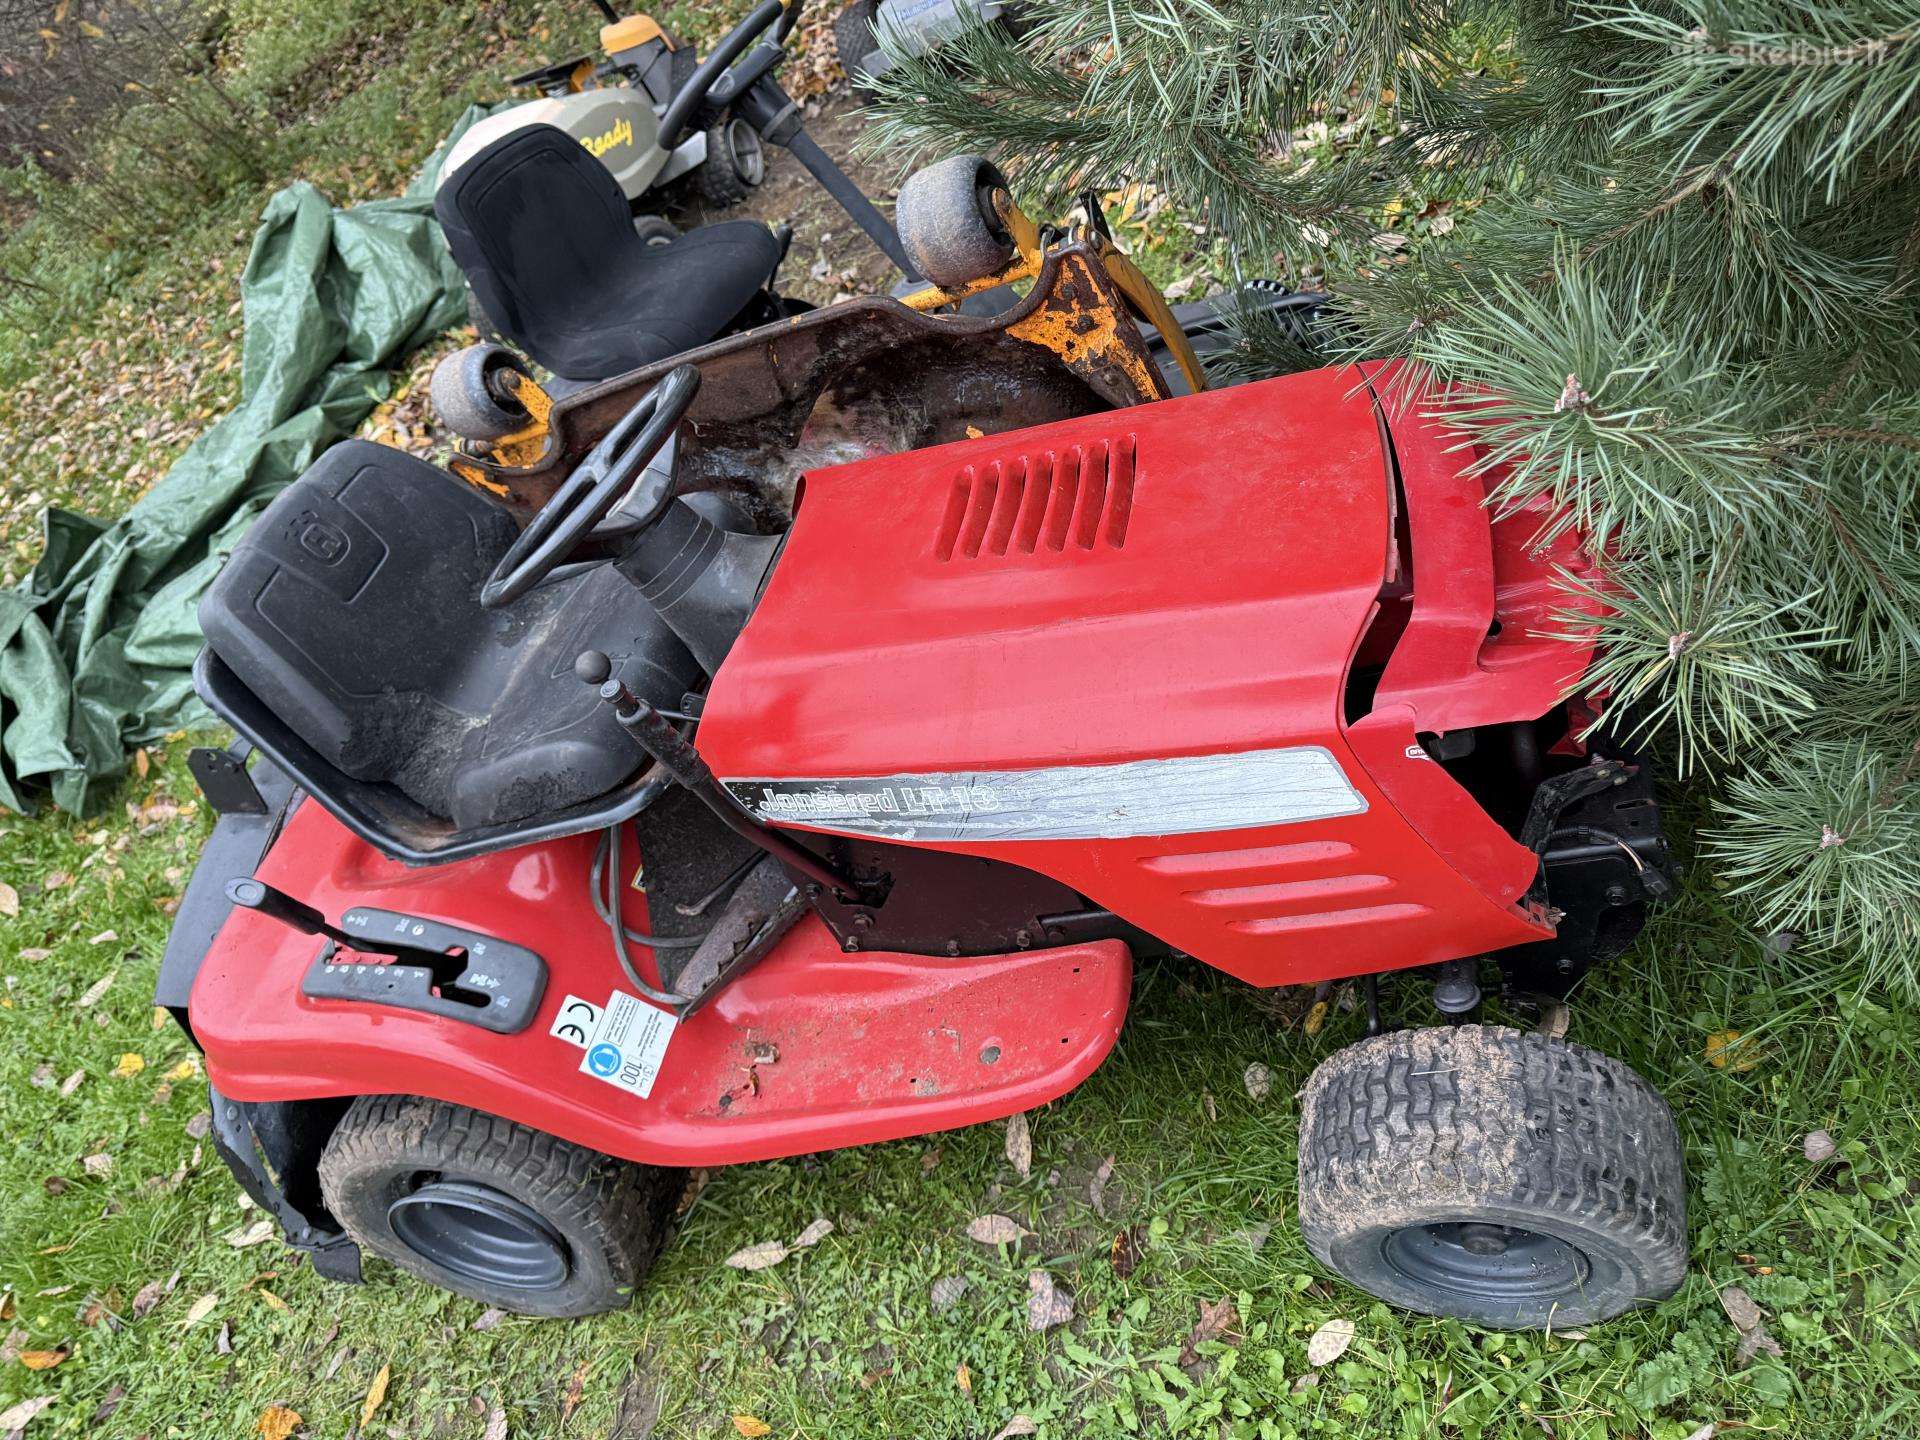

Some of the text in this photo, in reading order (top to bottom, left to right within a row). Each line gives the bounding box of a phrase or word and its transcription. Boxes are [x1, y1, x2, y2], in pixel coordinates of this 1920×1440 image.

[759, 785, 1000, 813] Jonsered LT 13
[620, 1060, 642, 1086] 100
